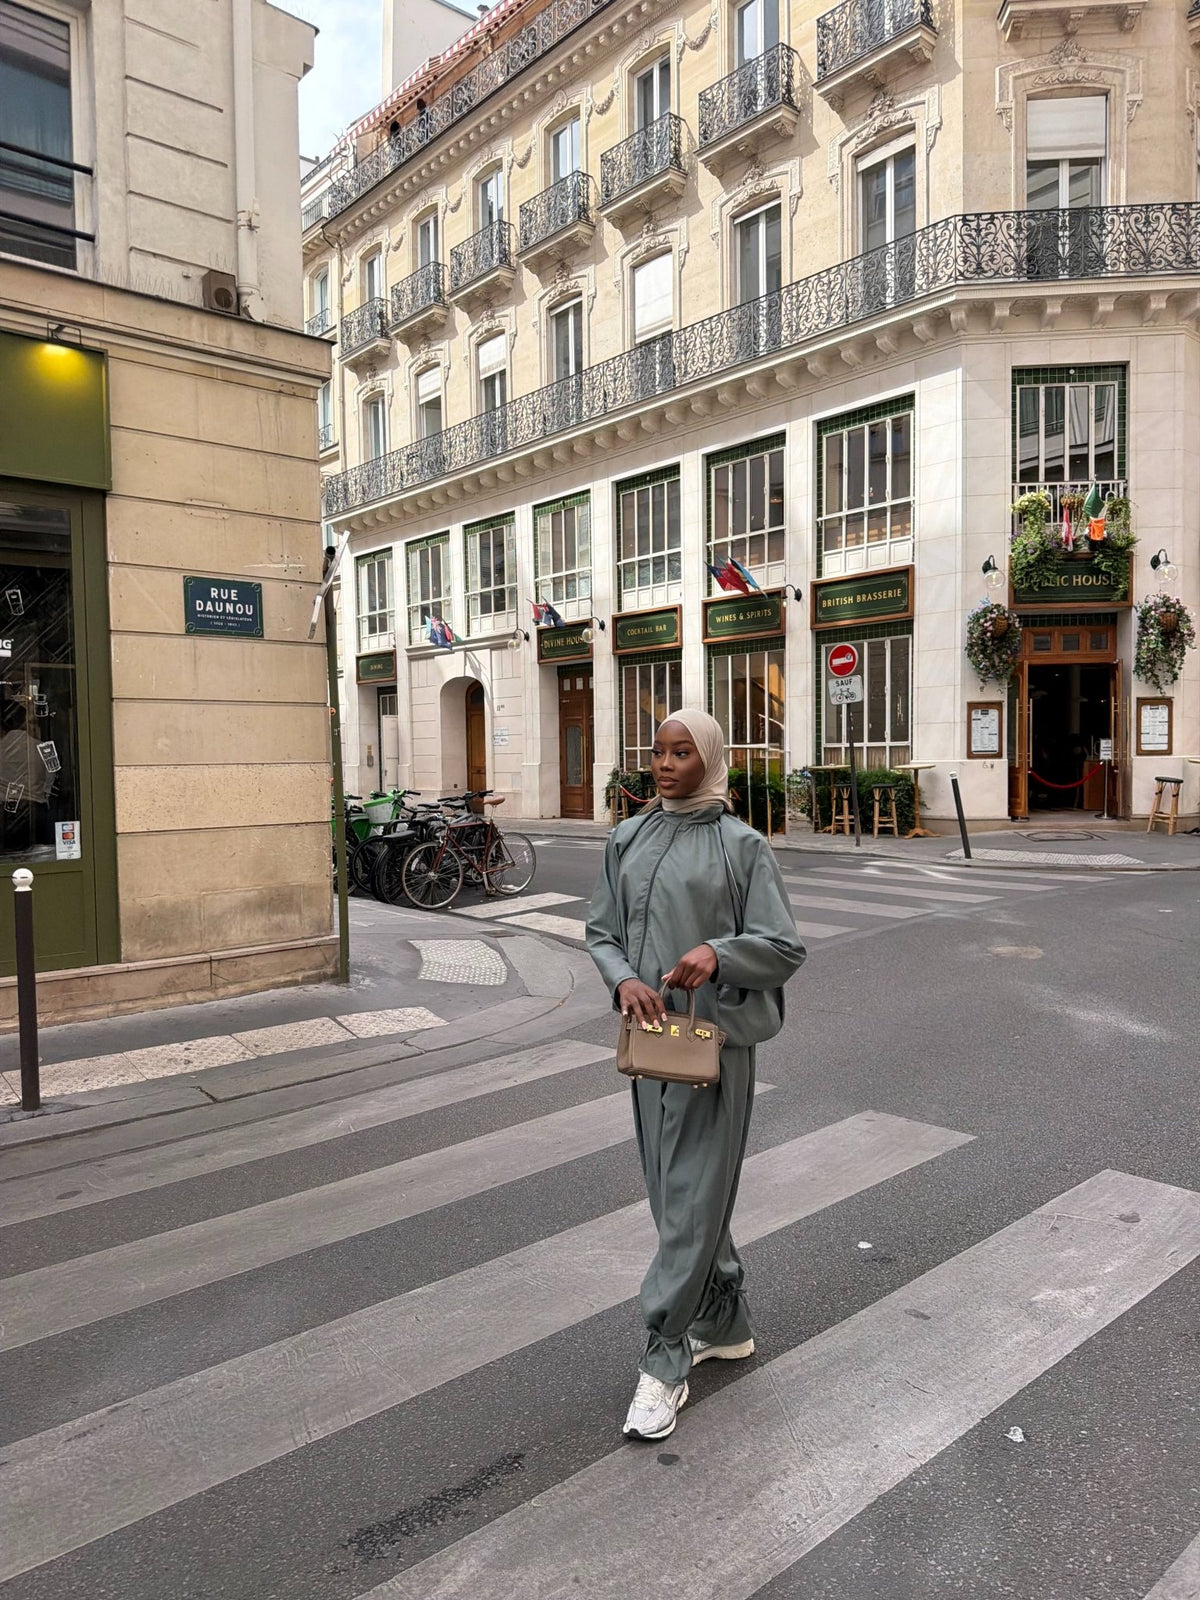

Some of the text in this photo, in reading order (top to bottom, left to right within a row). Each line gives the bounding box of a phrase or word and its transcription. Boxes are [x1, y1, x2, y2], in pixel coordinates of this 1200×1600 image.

[1072, 574, 1117, 586] HOUSE
[210, 587, 239, 601] RUE
[822, 588, 902, 608] BRITISH BRASSERIE
[195, 600, 254, 616] DAUNOU
[715, 608, 772, 624] WINES & SPIRITS
[626, 623, 668, 637] COCKTAIL BAR
[835, 679, 853, 687] SAUF
